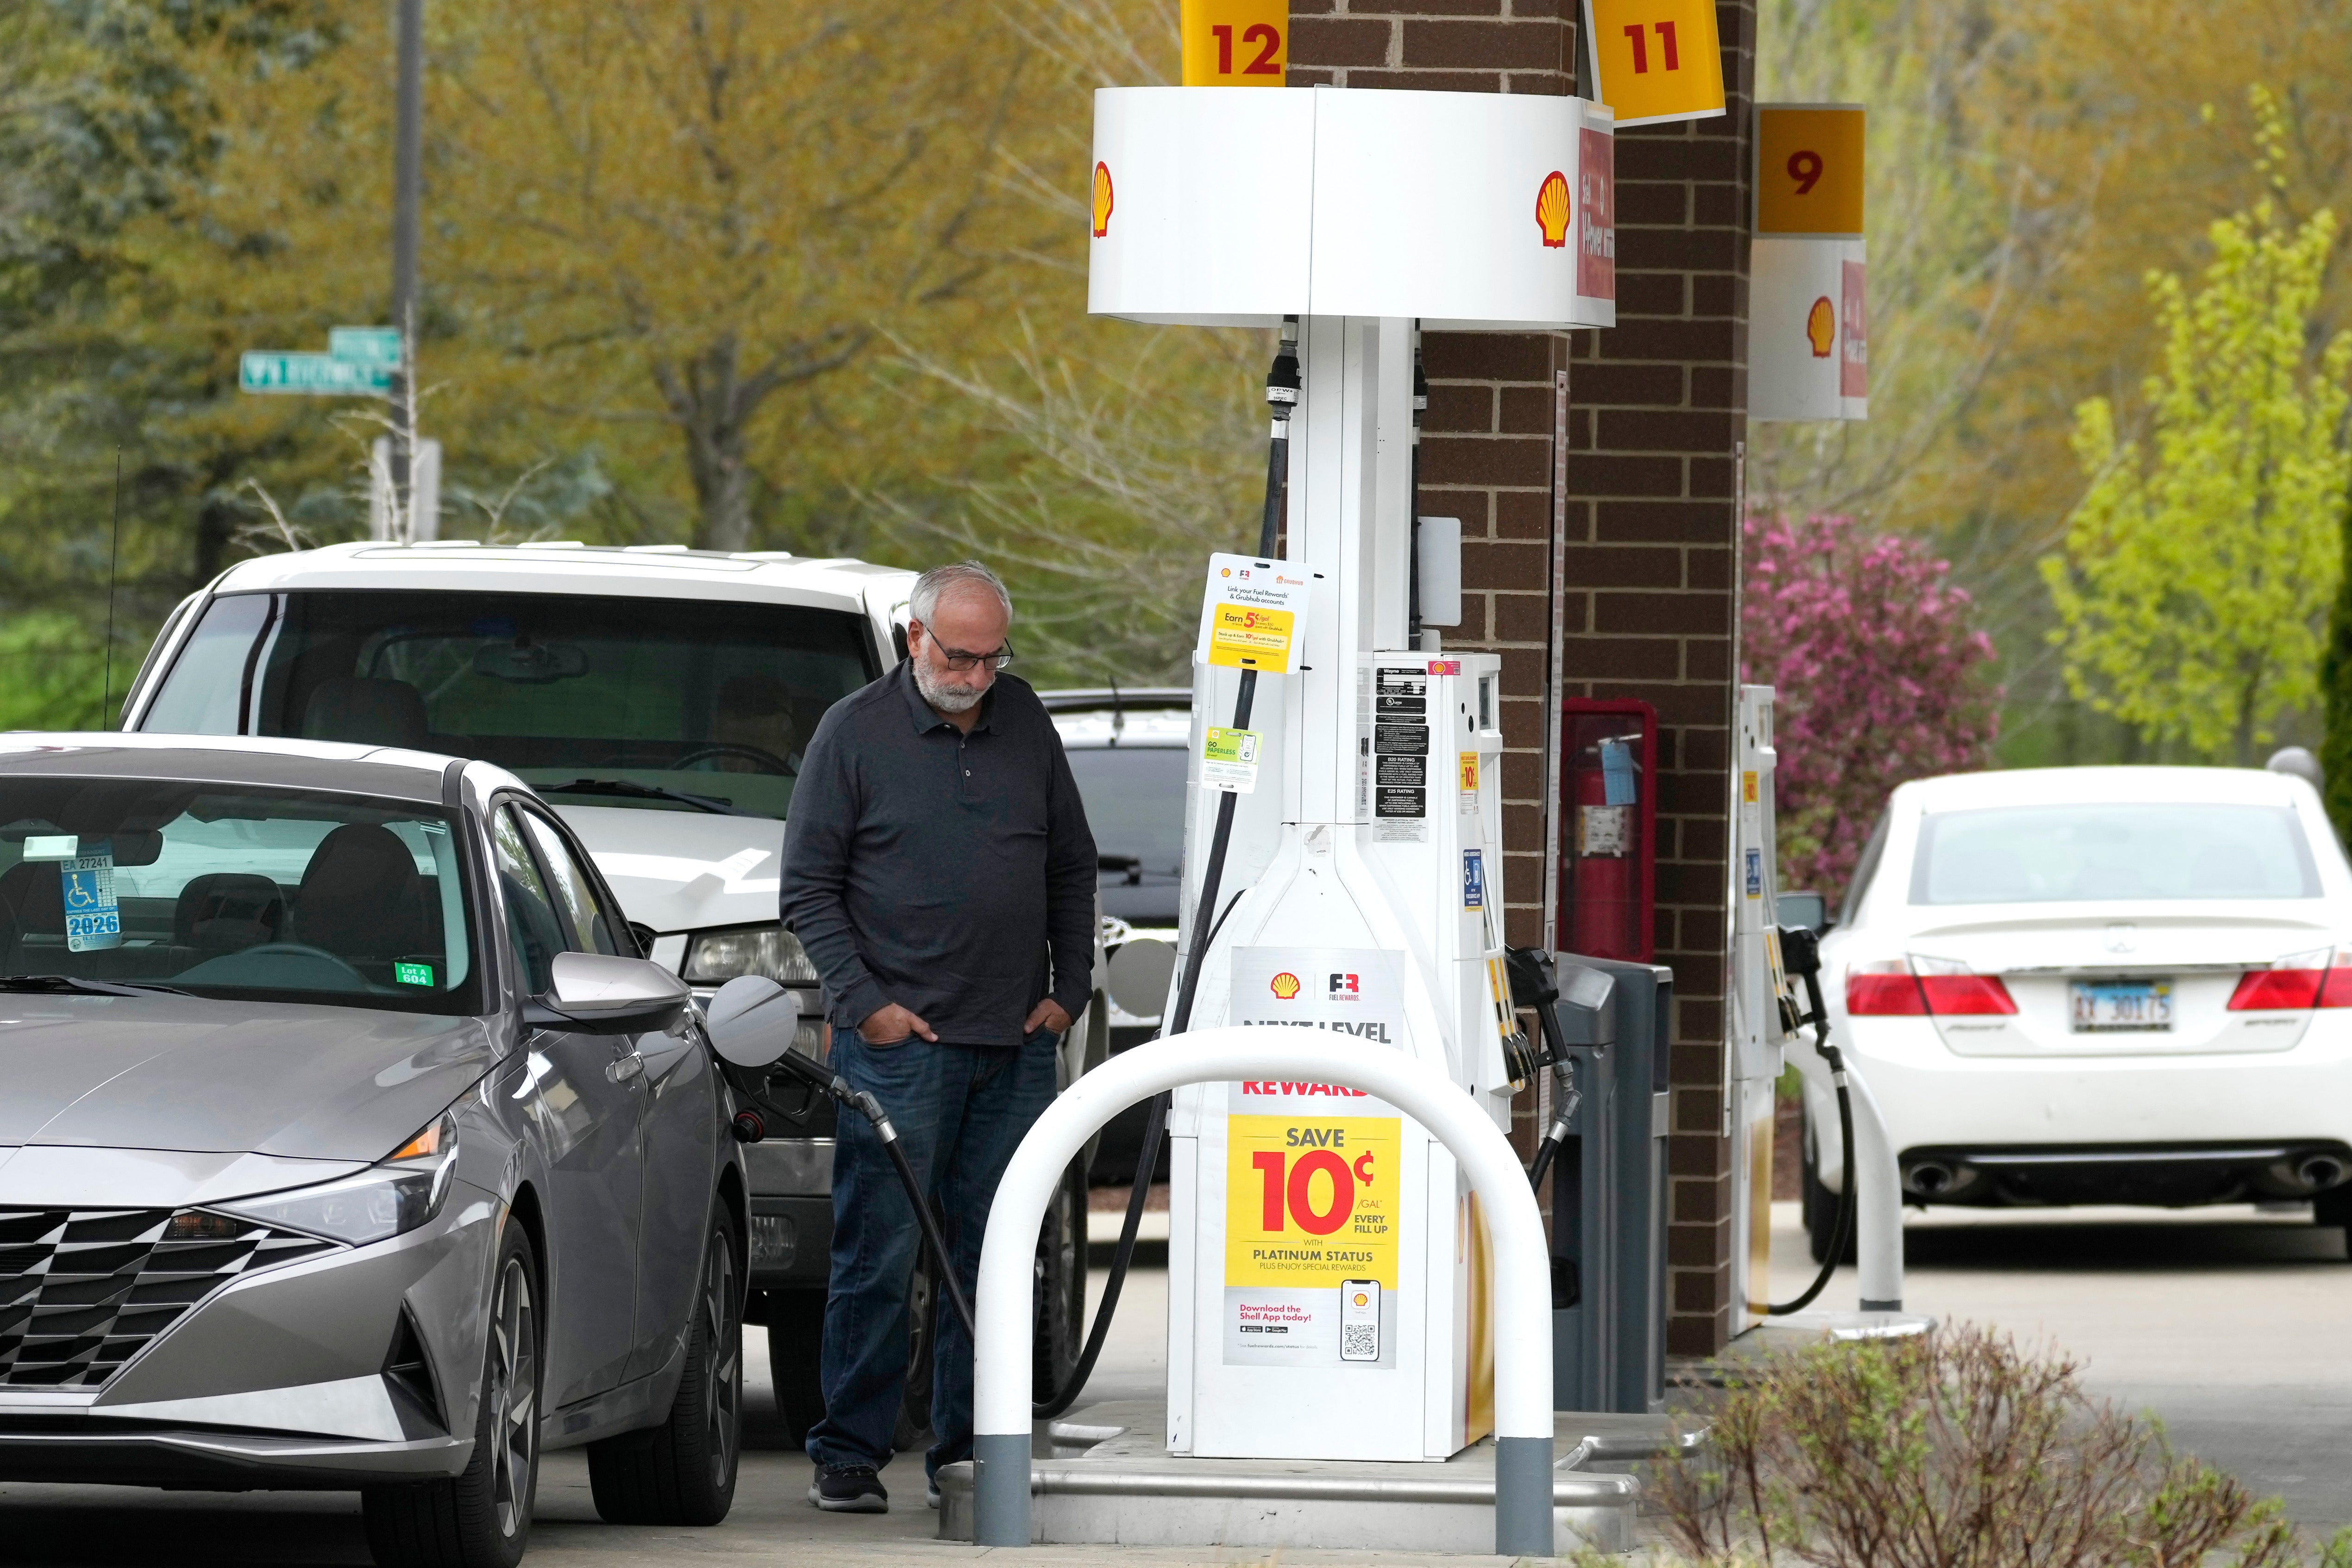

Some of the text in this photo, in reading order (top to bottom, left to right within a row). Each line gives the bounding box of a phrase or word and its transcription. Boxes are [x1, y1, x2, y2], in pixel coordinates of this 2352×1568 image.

[1211, 24, 1281, 75] 12
[1624, 21, 1679, 74] 11
[1787, 151, 1823, 194] 9
[1225, 613, 1242, 622] Earn
[63, 857, 107, 870] EA 27241
[69, 916, 118, 935] 2026
[401, 966, 417, 975] Lot
[403, 974, 426, 984] 604
[1286, 1128, 1344, 1148] SAVE
[1355, 1215, 1385, 1223] EVERY
[1355, 1225, 1388, 1234] FILL UP
[1253, 1249, 1373, 1261] PLATINUM STATUS
[1240, 1304, 1285, 1312] Download
[1263, 1313, 1280, 1322] App
[1283, 1314, 1311, 1323] today!
